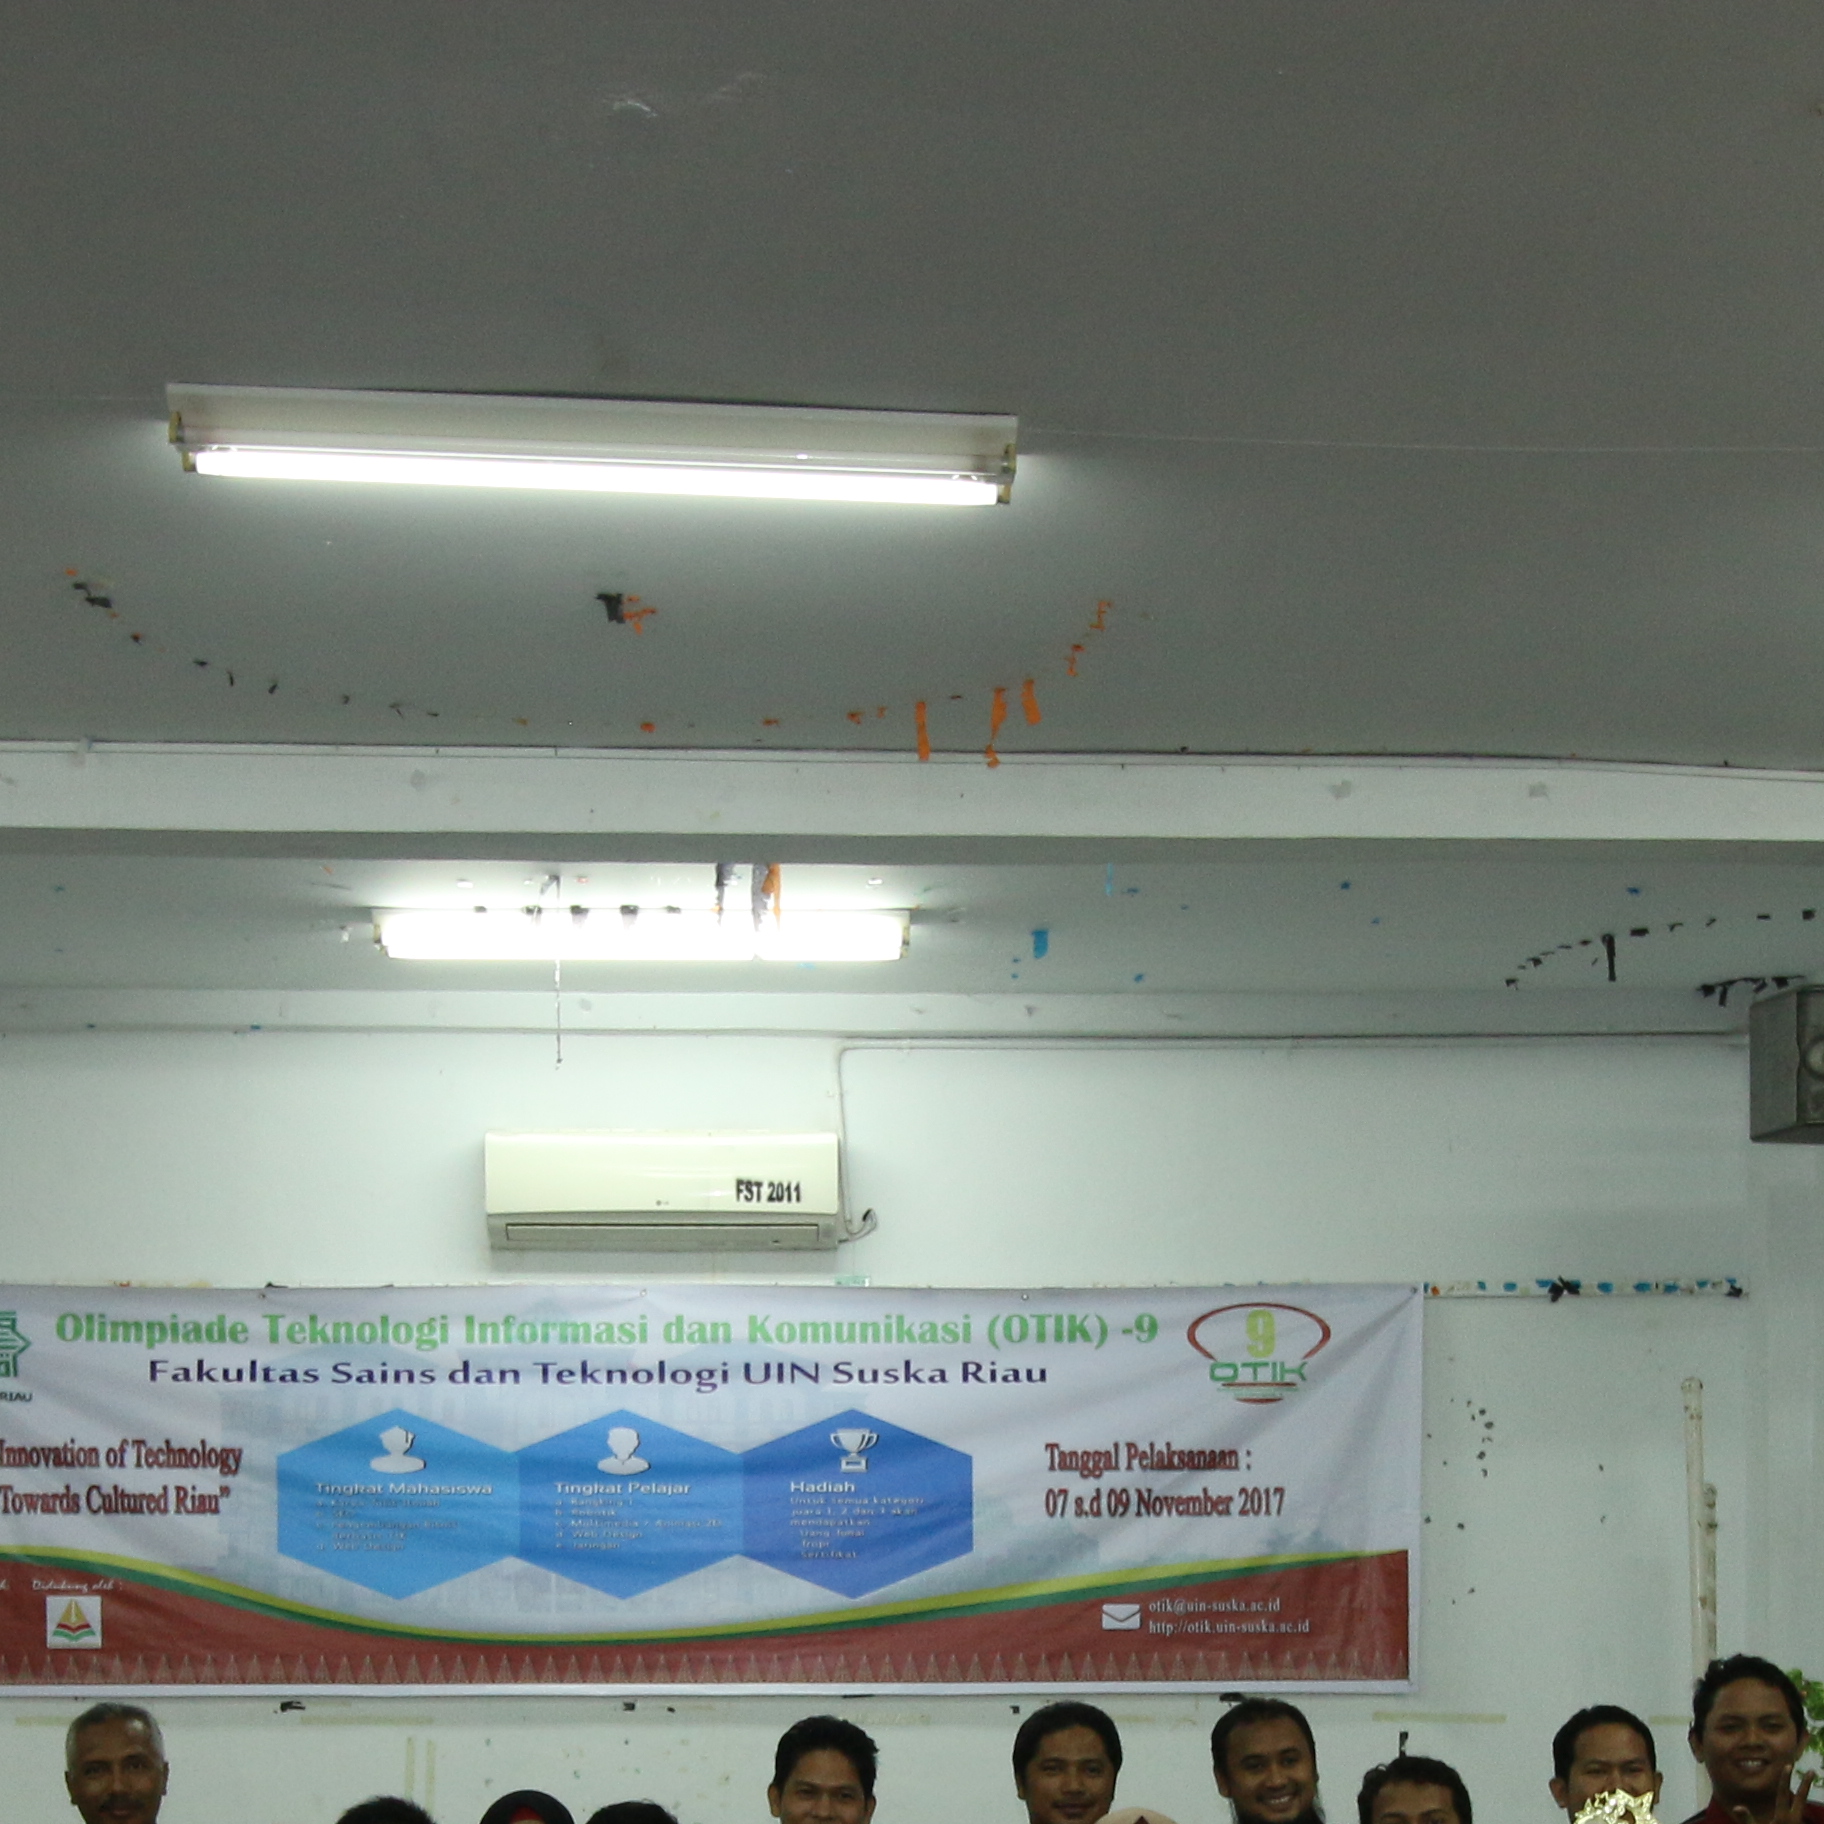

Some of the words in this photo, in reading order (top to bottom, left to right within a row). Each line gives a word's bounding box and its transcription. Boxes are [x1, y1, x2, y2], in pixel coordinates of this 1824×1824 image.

[736, 1178, 763, 1203] FST
[767, 1180, 802, 1203] 2011
[56, 1312, 249, 1350] Olimpiade
[261, 1312, 449, 1351] Teknologi
[464, 1313, 648, 1345] Informasi
[662, 1313, 732, 1345] dan
[747, 1313, 973, 1345] Komunikasi
[987, 1312, 1109, 1350] (OTIK)
[1121, 1312, 1159, 1343] -9
[1246, 1308, 1276, 1358] 9
[148, 1358, 320, 1385] Fakultas
[330, 1359, 437, 1386] Sains
[447, 1358, 521, 1386] dan
[532, 1360, 730, 1394] Teknologi
[742, 1360, 821, 1386] UIN
[831, 1360, 949, 1386] Suska
[960, 1360, 1048, 1386] Riau
[1208, 1361, 1308, 1382] OTIK
[105, 1438, 128, 1469] of
[131, 1438, 243, 1477] Technology
[1044, 1441, 1120, 1479] Tanggal
[1125, 1441, 1240, 1471] Pelaksanaan
[85, 1484, 169, 1516] Cultured
[175, 1484, 231, 1515] Riau”
[315, 1482, 384, 1496] Tingkat
[389, 1482, 494, 1496] Mahasiswa
[554, 1482, 623, 1496] Tingkat
[628, 1482, 692, 1496] Pelajar
[790, 1481, 856, 1494] Hadiah
[1044, 1487, 1069, 1518] 07
[1073, 1487, 1102, 1518] s.d
[1106, 1487, 1131, 1518] 09
[1134, 1487, 1234, 1517] November
[1238, 1486, 1286, 1517] 2017
[32, 1579, 90, 1594] Didukung
[91, 1580, 115, 1591] oleh
[1148, 1597, 1281, 1616] otik@uin-suska.ac.id
[1148, 1619, 1311, 1637] http://otik.uin-suska.ac.id
